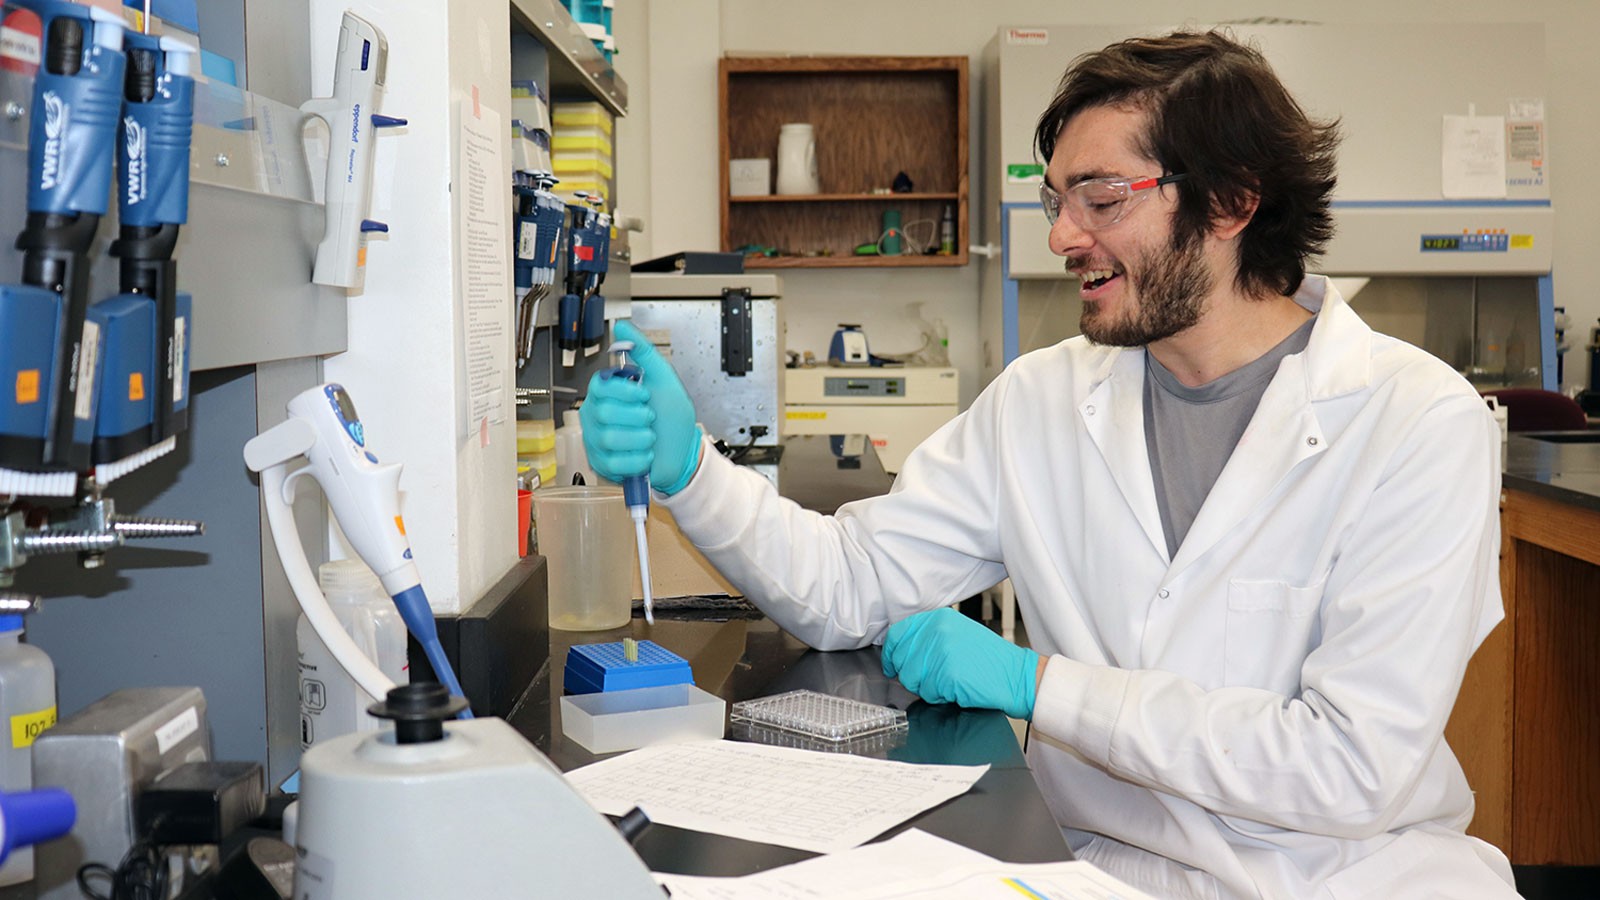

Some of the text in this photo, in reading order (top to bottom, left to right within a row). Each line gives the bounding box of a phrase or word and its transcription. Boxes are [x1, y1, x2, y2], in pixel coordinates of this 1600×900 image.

[352, 103, 360, 143] eppendorf
[41, 140, 58, 190] VWR
[127, 160, 140, 205] VWR
